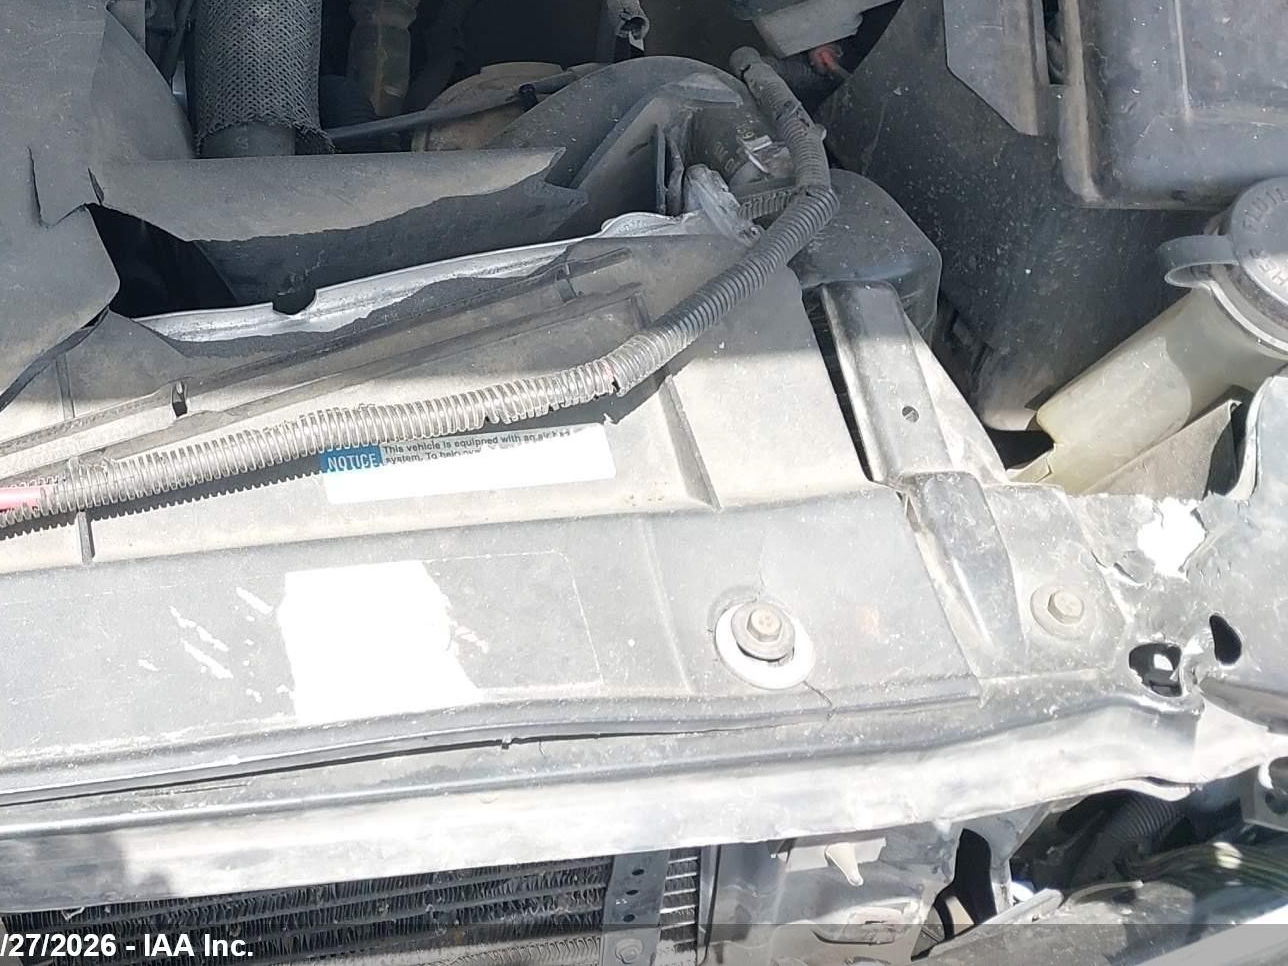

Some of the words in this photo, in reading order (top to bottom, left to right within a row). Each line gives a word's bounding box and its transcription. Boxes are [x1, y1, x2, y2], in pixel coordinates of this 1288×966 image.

[384, 444, 404, 454] This
[406, 440, 441, 452] vehicle
[443, 440, 452, 449] is
[500, 433, 521, 443] with
[327, 452, 378, 472] NOTICE
